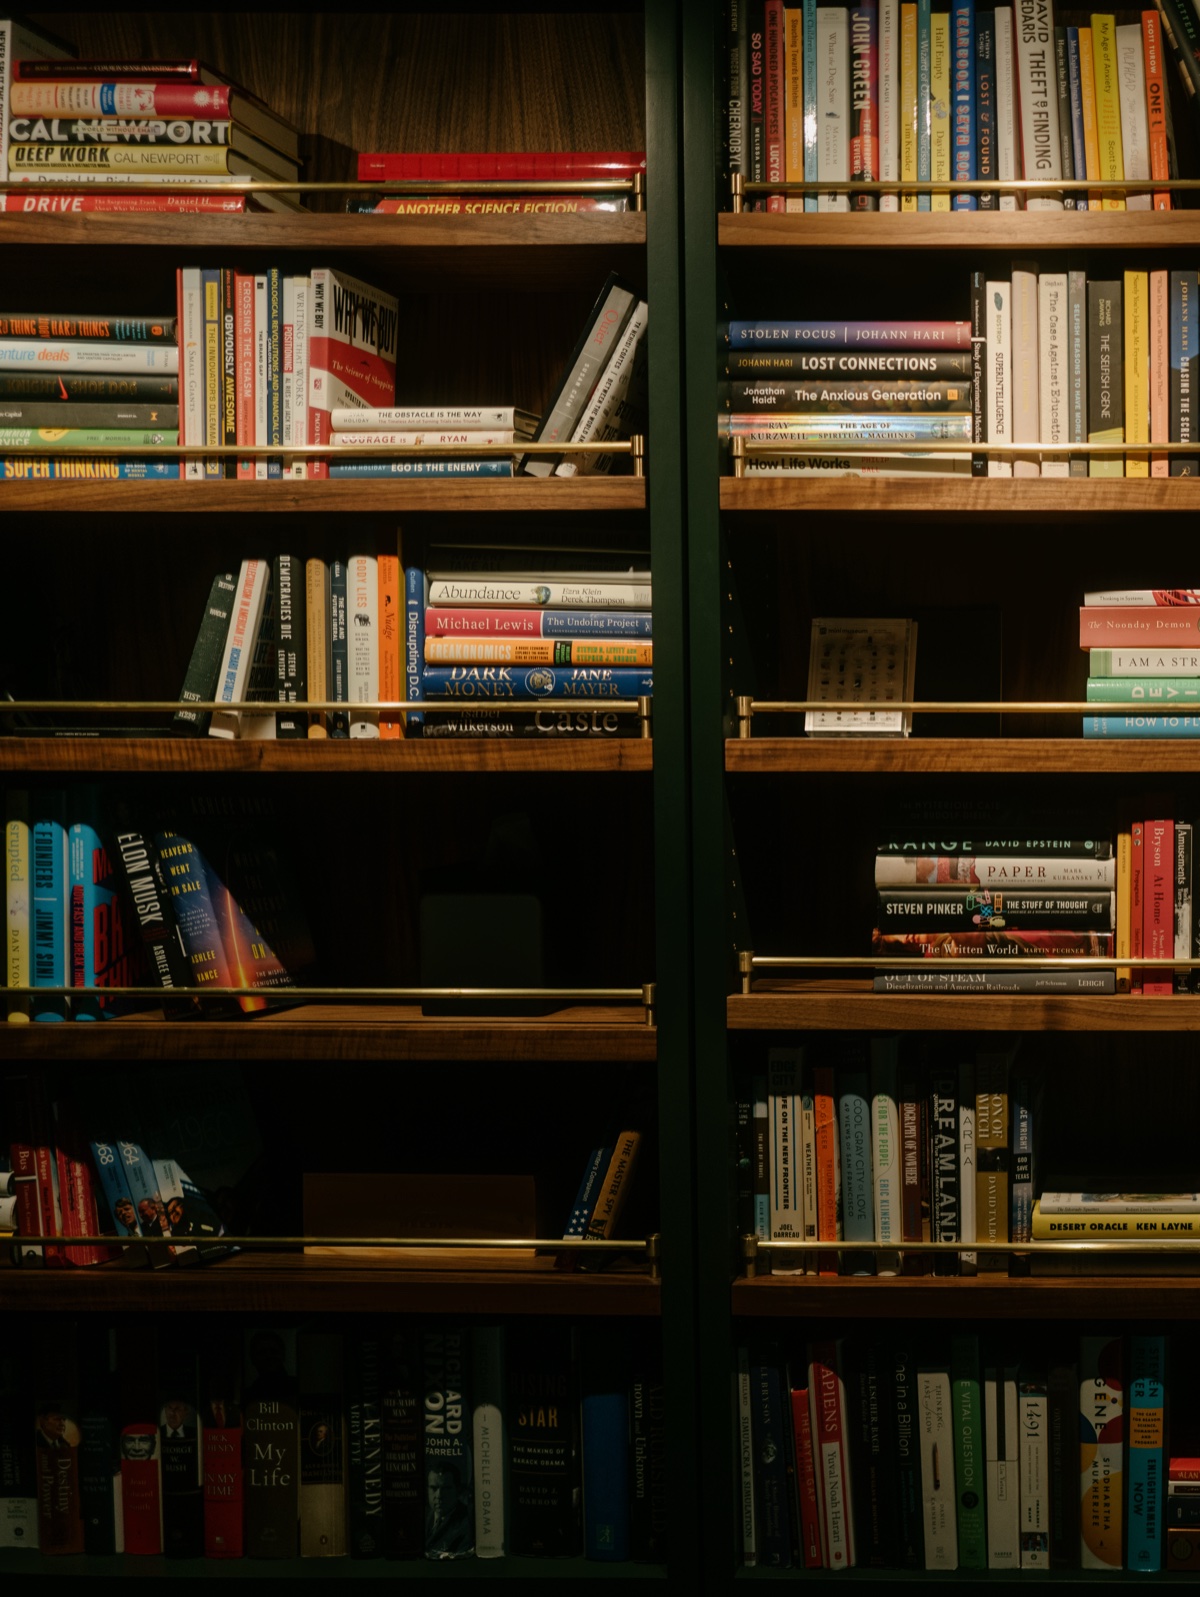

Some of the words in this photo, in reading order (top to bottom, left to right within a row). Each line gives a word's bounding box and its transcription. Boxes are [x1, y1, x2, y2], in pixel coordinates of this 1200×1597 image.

[853, 13, 870, 53] JOHN
[1030, 50, 1047, 97] THEFT
[853, 58, 870, 111] GREEN
[8, 119, 69, 141] CAL
[73, 120, 229, 144] NEWPORT
[1034, 112, 1051, 169] FINDING
[15, 147, 51, 162] DEEP
[60, 148, 110, 162] WORK
[114, 153, 137, 164] CAL
[141, 154, 200, 164] NEWPORT
[397, 204, 460, 215] ANOTHER
[465, 204, 520, 214] SCIENCE
[524, 203, 577, 214] FICTION
[741, 330, 789, 339] STOLEN
[794, 330, 836, 339] FOCUS
[856, 330, 908, 340] JOHANN
[913, 331, 945, 340] HARI
[284, 326, 292, 371] POSITIONING
[1101, 335, 1110, 351] THE
[738, 359, 771, 367] JOHANN
[773, 359, 793, 367] HARI
[802, 357, 836, 370] LOST
[839, 357, 937, 370] CONNECTIONS
[1101, 355, 1110, 389] SELFISH
[743, 387, 785, 396] Jonathan
[795, 391, 818, 401] The
[820, 390, 868, 401] Anxious
[871, 390, 941, 401] Generation
[995, 352, 1004, 434] SUPERINTELLIGENCE
[752, 396, 776, 405] Haidt
[1101, 391, 1110, 419] GENE
[378, 411, 393, 419] THE
[395, 411, 434, 419] OBSTACLE
[5, 457, 50, 478] SUPER
[54, 457, 119, 479] THINKING
[391, 463, 412, 473] EGO
[414, 463, 423, 472] IS
[426, 463, 445, 472] THE
[448, 463, 481, 472] ENEMY
[749, 459, 778, 469] How
[782, 458, 805, 470] Life
[808, 459, 850, 469] Works
[438, 585, 521, 600] Abundance
[436, 617, 491, 630] Michael
[495, 618, 533, 631] Lewis
[548, 617, 564, 626] The
[567, 617, 605, 627] Undoing
[607, 618, 639, 628] Project
[1107, 620, 1151, 630] Noonday
[1156, 620, 1191, 629] Demon
[1118, 658, 1122, 667] I
[1129, 657, 1149, 667] AM
[1156, 657, 1164, 667] A
[571, 670, 612, 680] JANE
[563, 683, 620, 695] MAYER
[35, 831, 53, 889] FOUNDERS
[988, 866, 1046, 877] PAPER
[129, 877, 164, 926] MUSK
[886, 903, 924, 915] STEVEN
[927, 903, 963, 915] PINKER
[1006, 901, 1019, 909] THE
[1021, 901, 1042, 909] STUFF
[1044, 901, 1053, 909] OF
[1056, 901, 1088, 910] THOUGHT
[621, 1139, 634, 1158] THE
[610, 1159, 627, 1195] MASTER
[603, 1197, 615, 1215] SPY
[1050, 1223, 1086, 1231] DESERT
[1090, 1223, 1128, 1231] ORACLE
[1137, 1223, 1157, 1231] KEN
[259, 1401, 279, 1414] Bill
[246, 1418, 294, 1431] Clinton
[254, 1443, 287, 1465] My
[962, 1426, 974, 1486] QUESTION
[250, 1467, 290, 1486] Life
[1134, 1482, 1143, 1516] NOW
